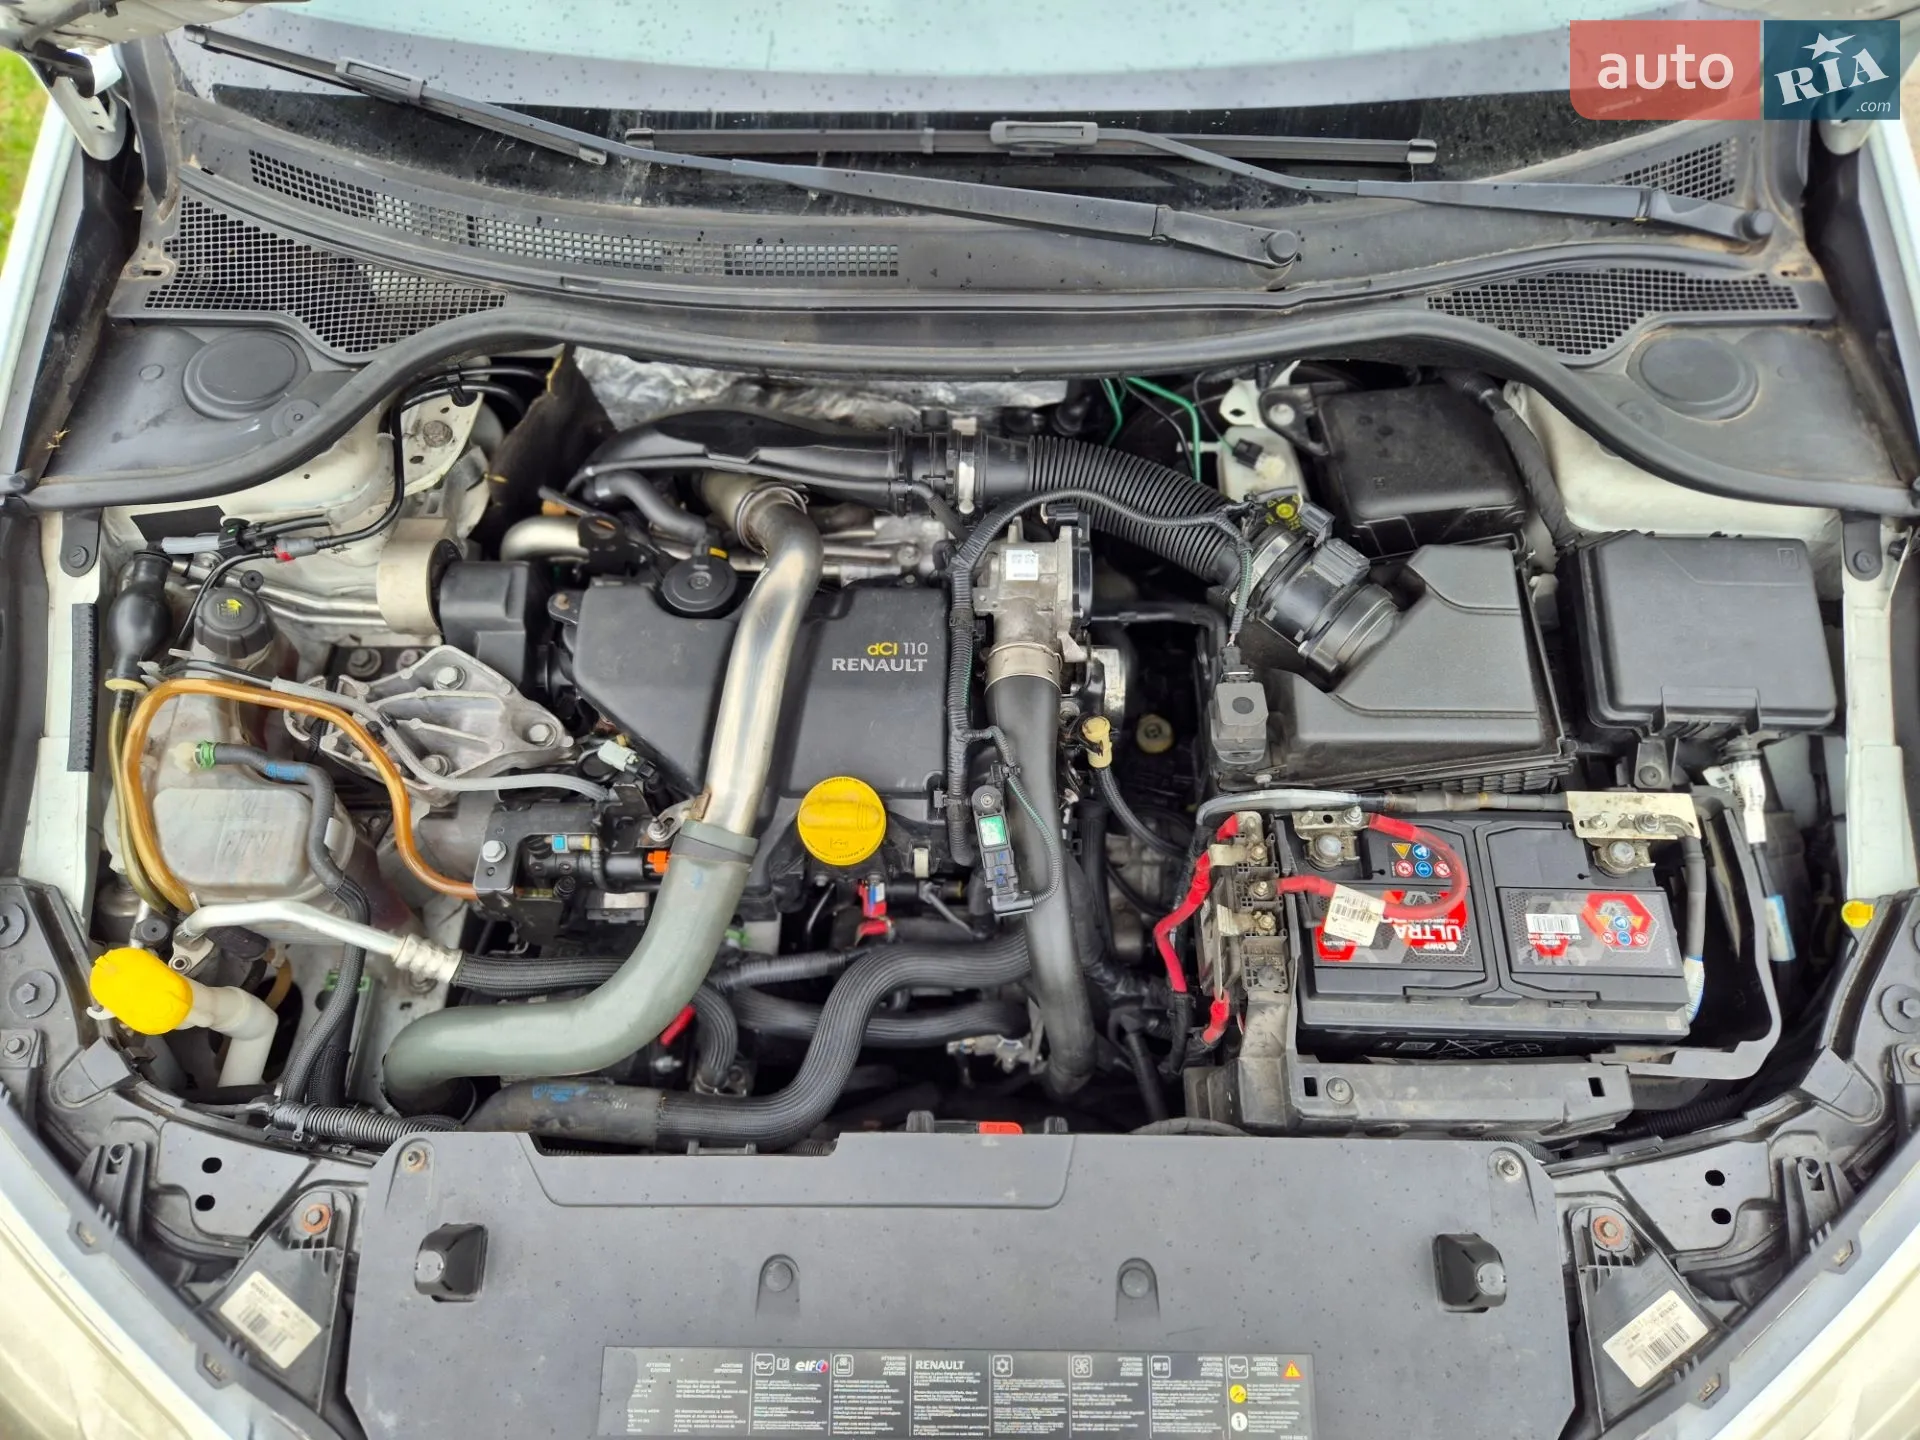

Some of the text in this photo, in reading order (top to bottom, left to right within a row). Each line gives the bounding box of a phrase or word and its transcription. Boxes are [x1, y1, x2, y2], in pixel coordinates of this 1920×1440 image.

[903, 642, 928, 656] 110
[832, 658, 928, 672] RENAULT
[1392, 924, 1462, 941] ULTRA
[794, 1360, 817, 1372] elf
[915, 1360, 965, 1370] RENAULT
